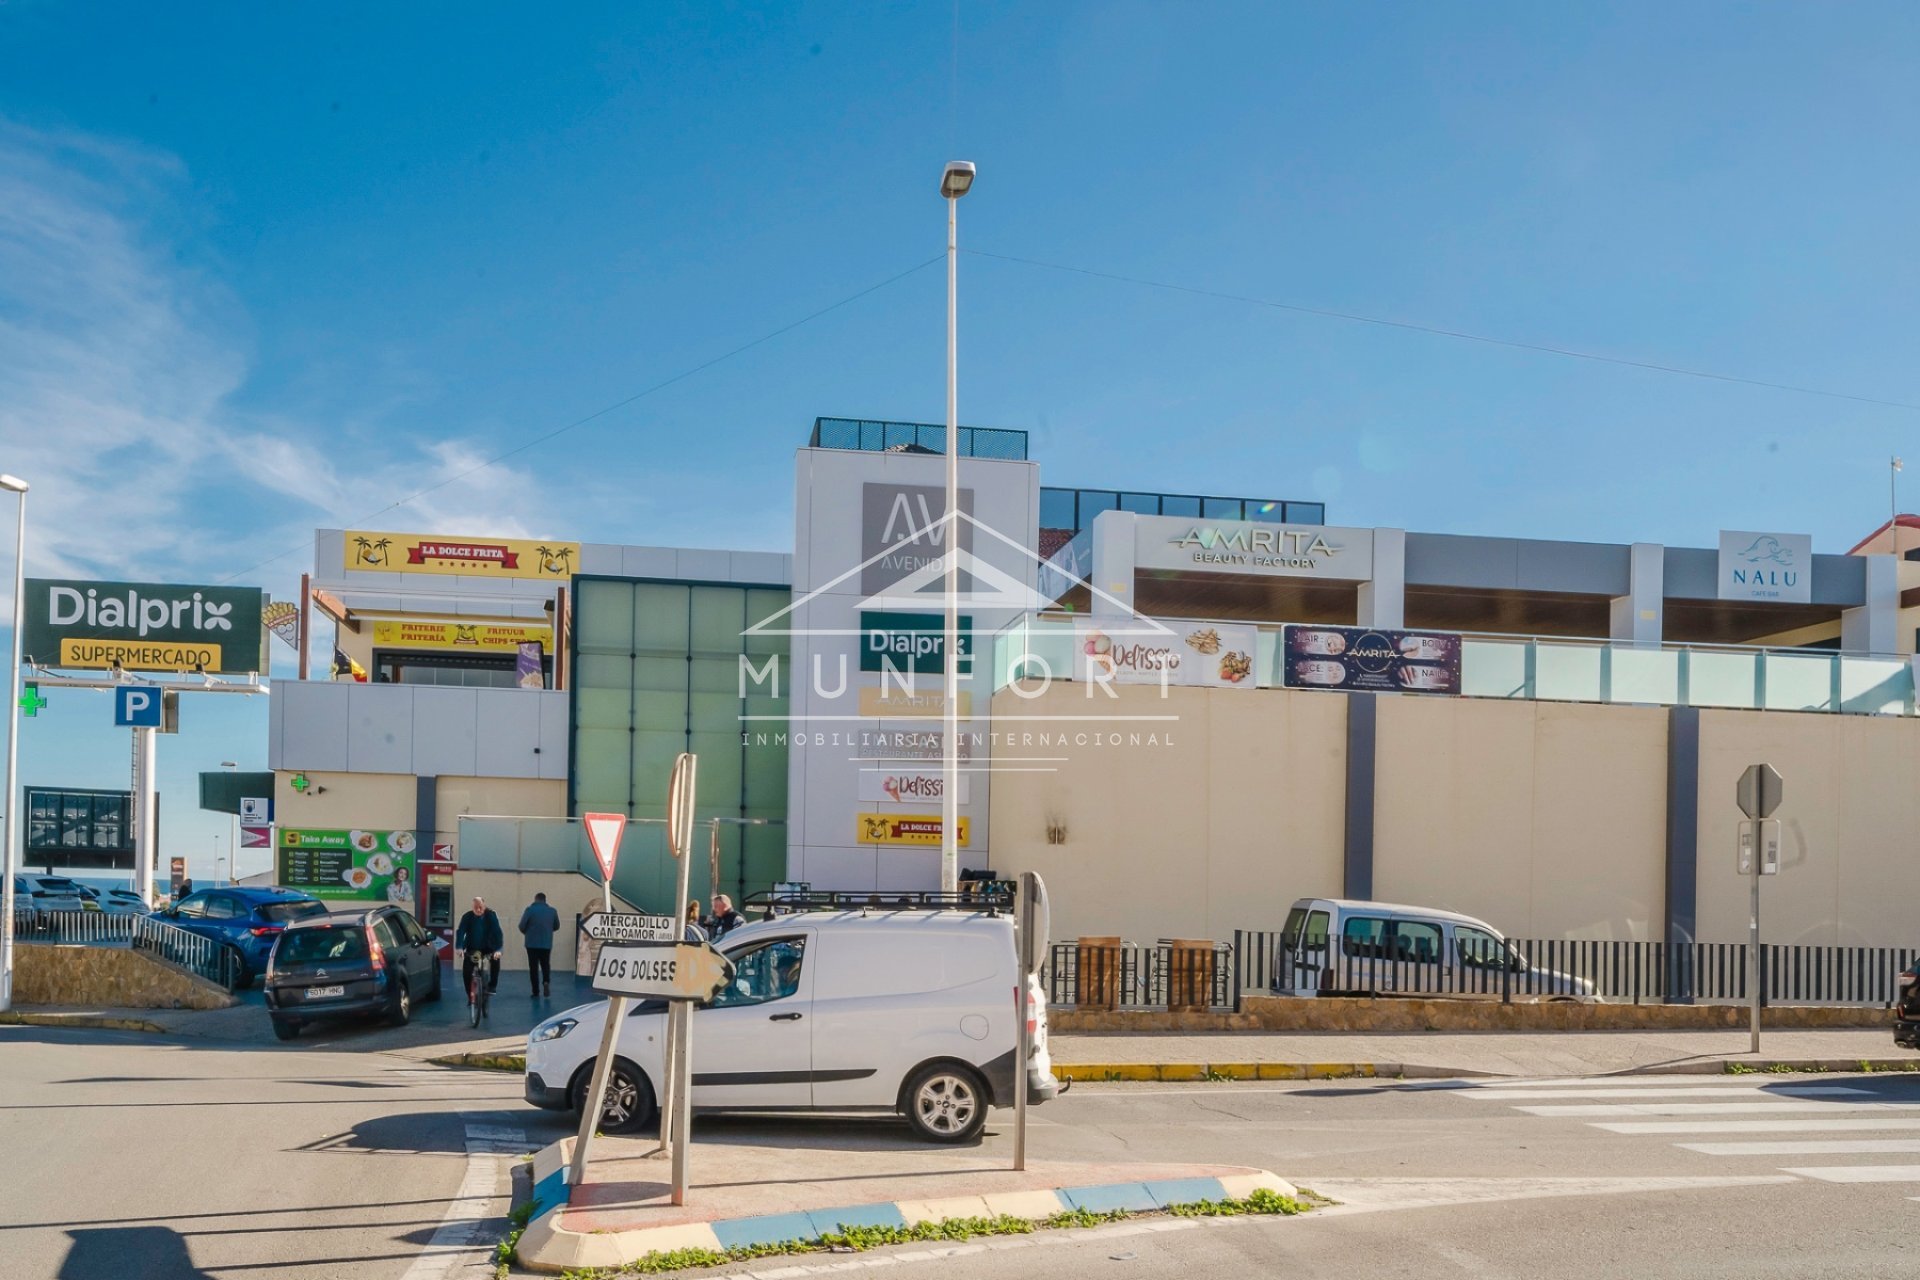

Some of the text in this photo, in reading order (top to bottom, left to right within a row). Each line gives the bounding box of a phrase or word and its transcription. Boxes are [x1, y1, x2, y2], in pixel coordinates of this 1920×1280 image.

[1172, 527, 1342, 556] AMRITA
[421, 546, 504, 558] LA DOLCE FRITA
[881, 555, 945, 571] AVENID
[1194, 553, 1316, 569] BEAUTY FACTORY
[1733, 569, 1797, 587] NALU
[49, 586, 233, 637] Dialprix
[401, 624, 446, 632] FRITERIE
[487, 627, 525, 636] FRITUUR
[401, 633, 446, 642] FRITERÍA
[482, 636, 508, 645] CHIPS
[869, 629, 966, 659] Dialprx
[71, 645, 211, 666] SUPERMERCADO
[1349, 649, 1398, 658] AMRITA
[126, 692, 150, 721] P
[874, 692, 945, 708] AMRIT
[899, 776, 943, 797] Delissi
[301, 835, 345, 845] Take Away
[600, 915, 670, 929] MERCADILLO
[599, 958, 677, 981] LOS DOLSES
